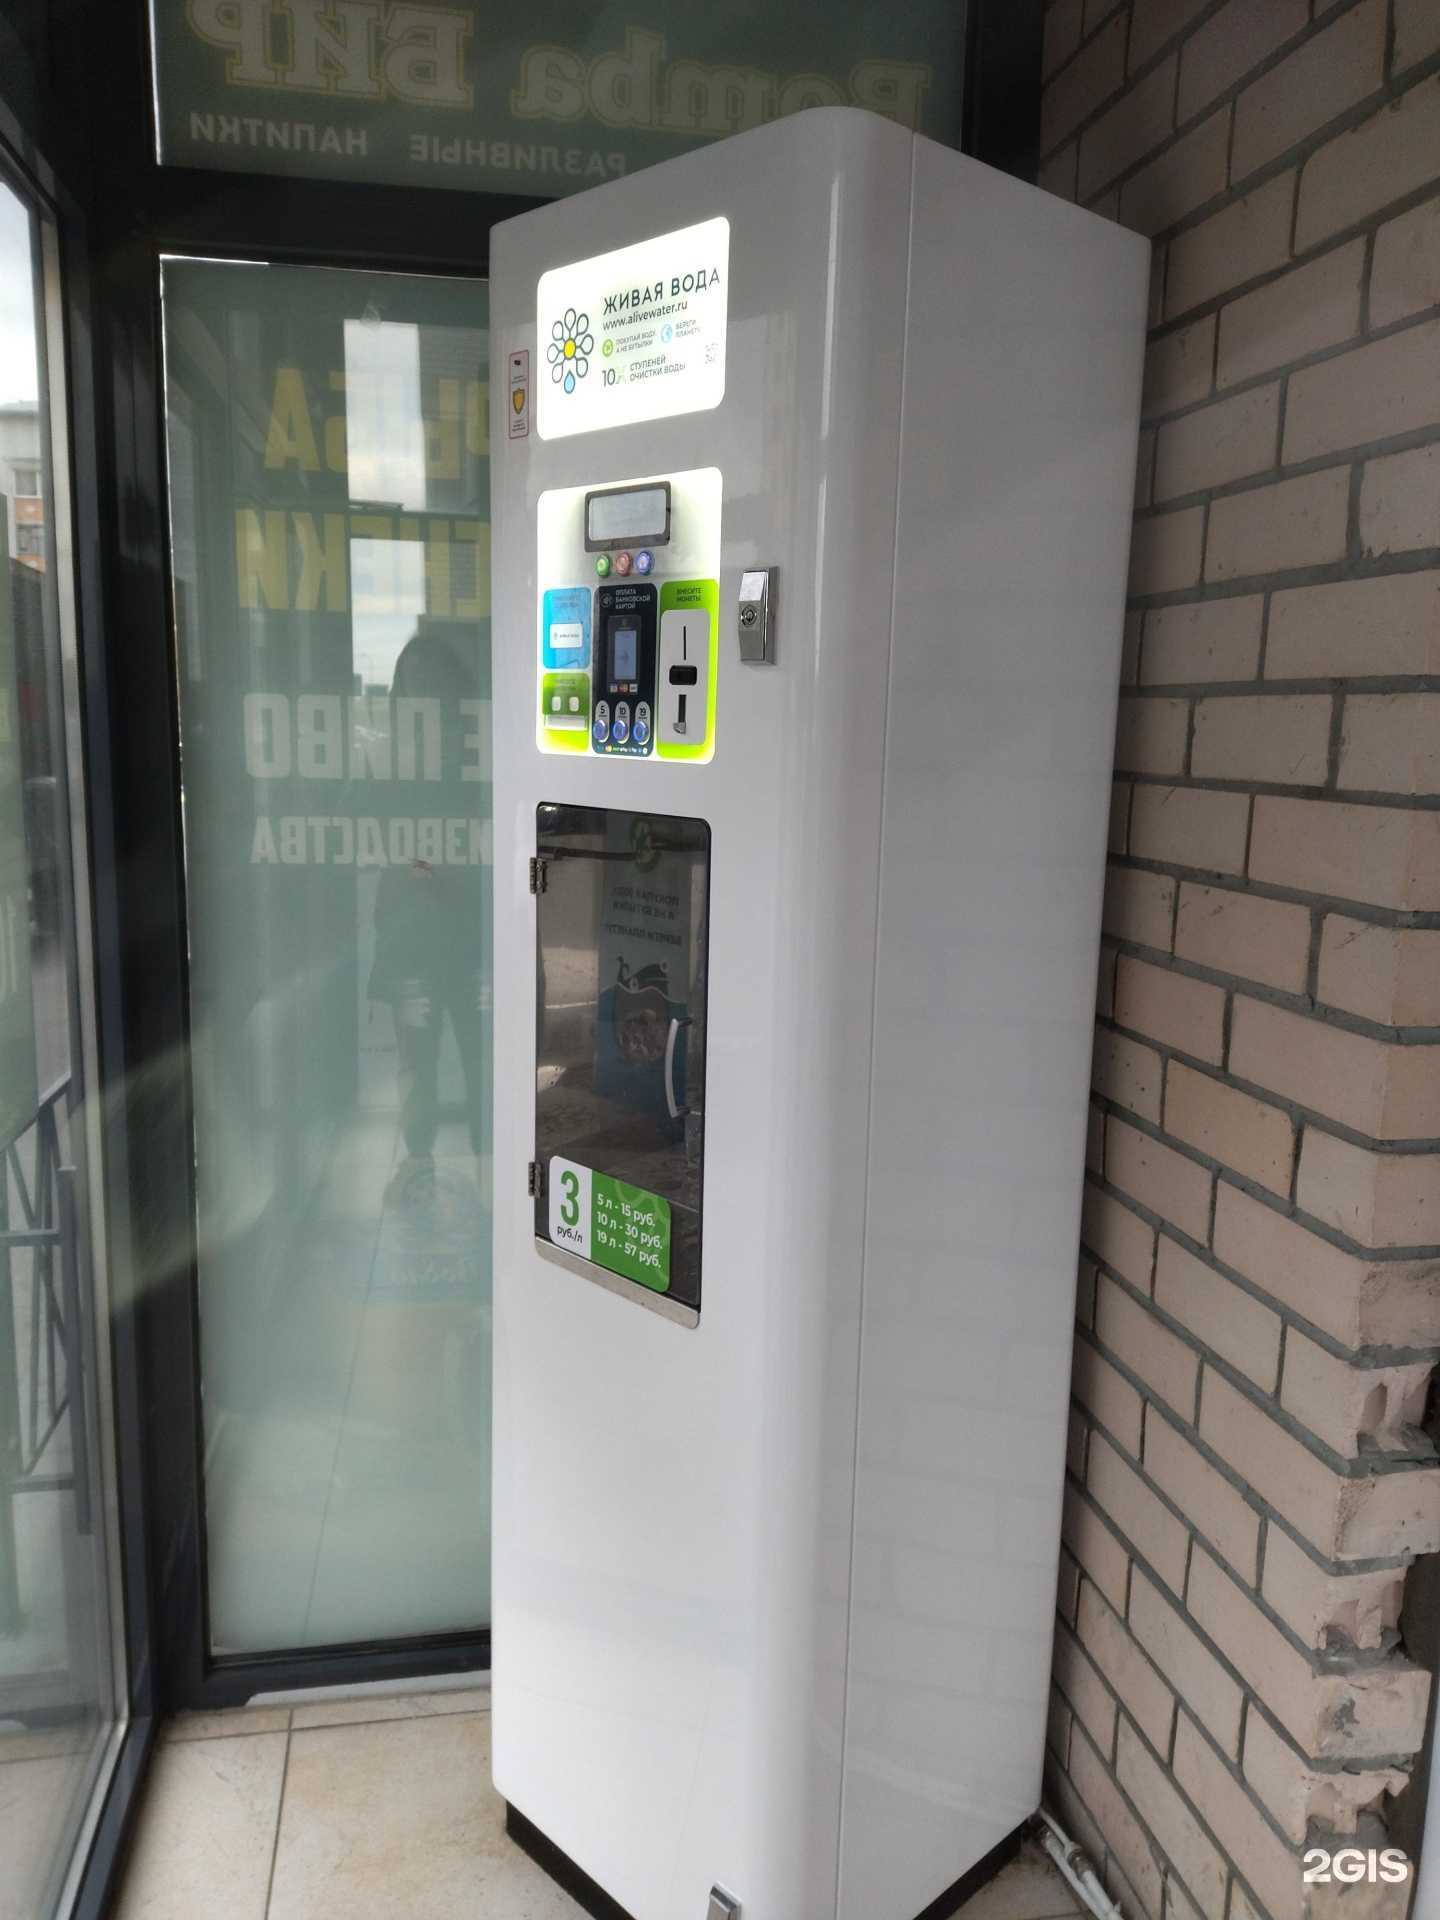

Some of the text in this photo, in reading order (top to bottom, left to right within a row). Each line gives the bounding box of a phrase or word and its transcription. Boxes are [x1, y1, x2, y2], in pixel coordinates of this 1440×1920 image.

[603, 268, 720, 315] ЖИВАЯ ВОДА
[603, 300, 687, 330] www.alivewater.ru
[602, 368, 616, 387] 10
[630, 354, 666, 371] СТУПЕНЕЙ
[630, 362, 685, 381] ОЧИСТКИ ВОДЫ
[560, 1170, 579, 1226] 3
[597, 1193, 604, 1205] 5
[605, 1200, 613, 1209] л
[620, 1203, 631, 1217] 15
[633, 1209, 655, 1227] руб.
[557, 1226, 583, 1244] руб./л
[597, 1211, 608, 1225] 10
[609, 1220, 616, 1230] л
[625, 1224, 638, 1238] 30
[640, 1230, 663, 1249] руб.
[597, 1230, 607, 1243] 19
[609, 1239, 616, 1248] л
[624, 1242, 636, 1255] 57
[639, 1250, 661, 1268] руб.
